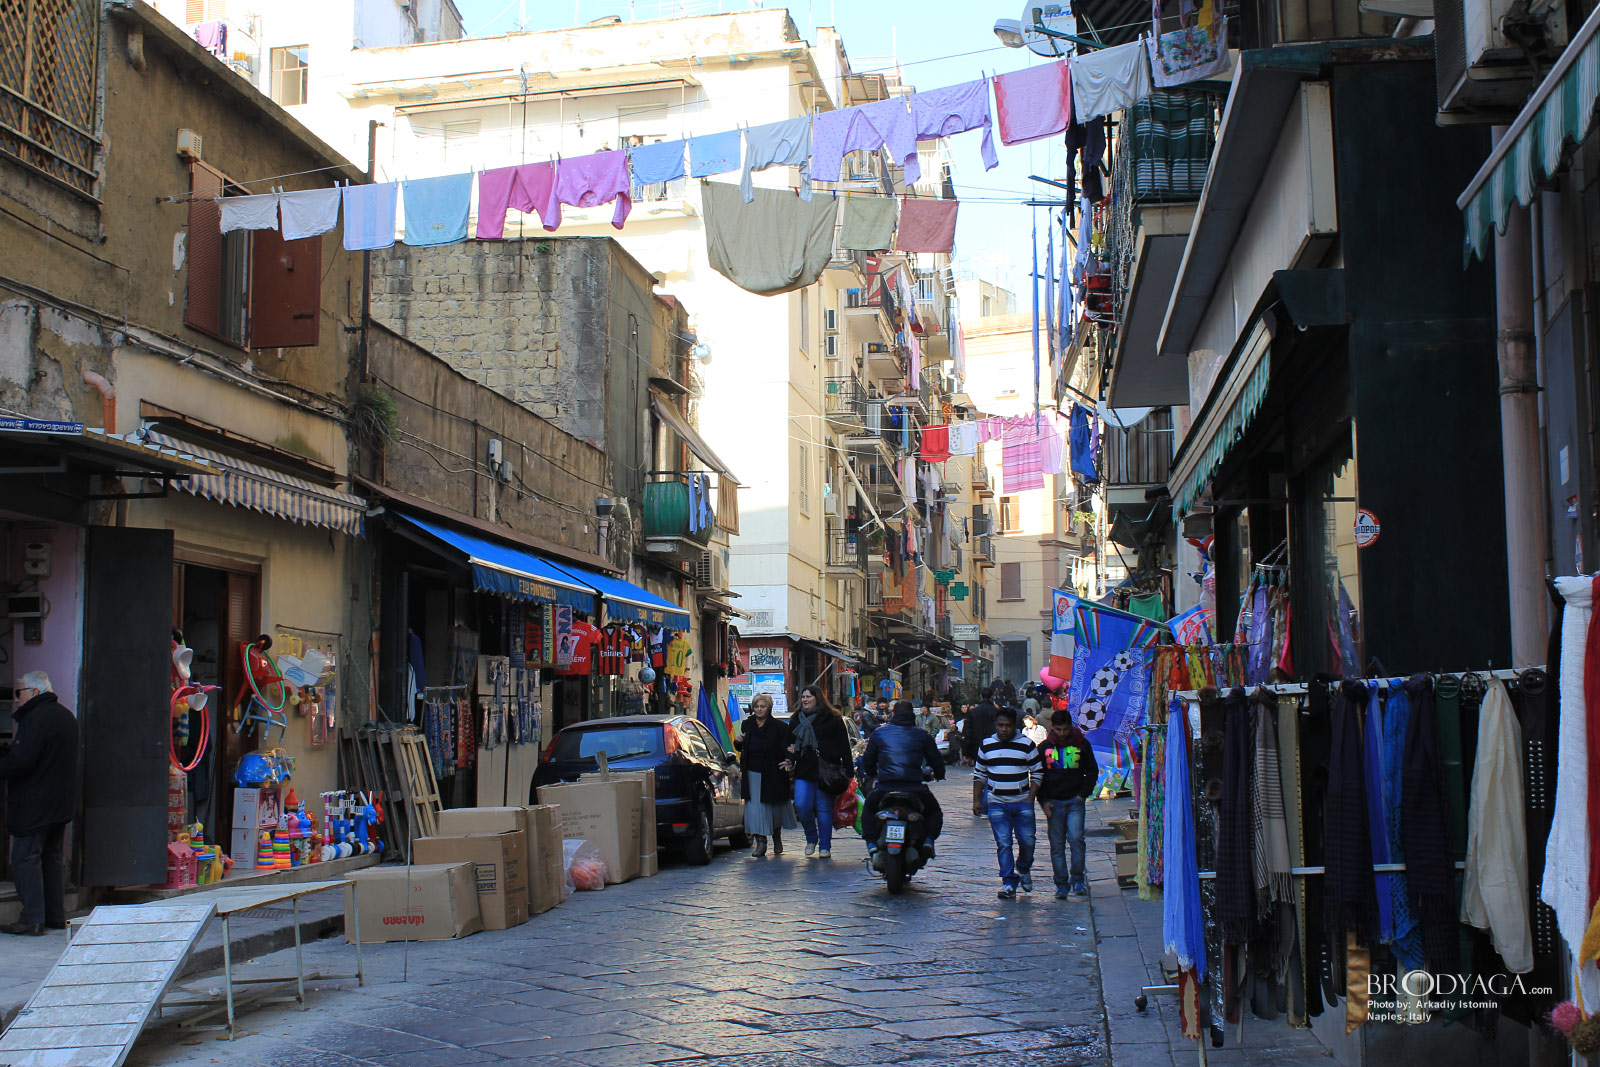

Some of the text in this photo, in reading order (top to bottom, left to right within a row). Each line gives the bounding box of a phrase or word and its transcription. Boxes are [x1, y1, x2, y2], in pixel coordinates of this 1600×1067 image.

[559, 605, 571, 634] NA
[543, 624, 553, 648] PEACE
[671, 649, 684, 668] 10
